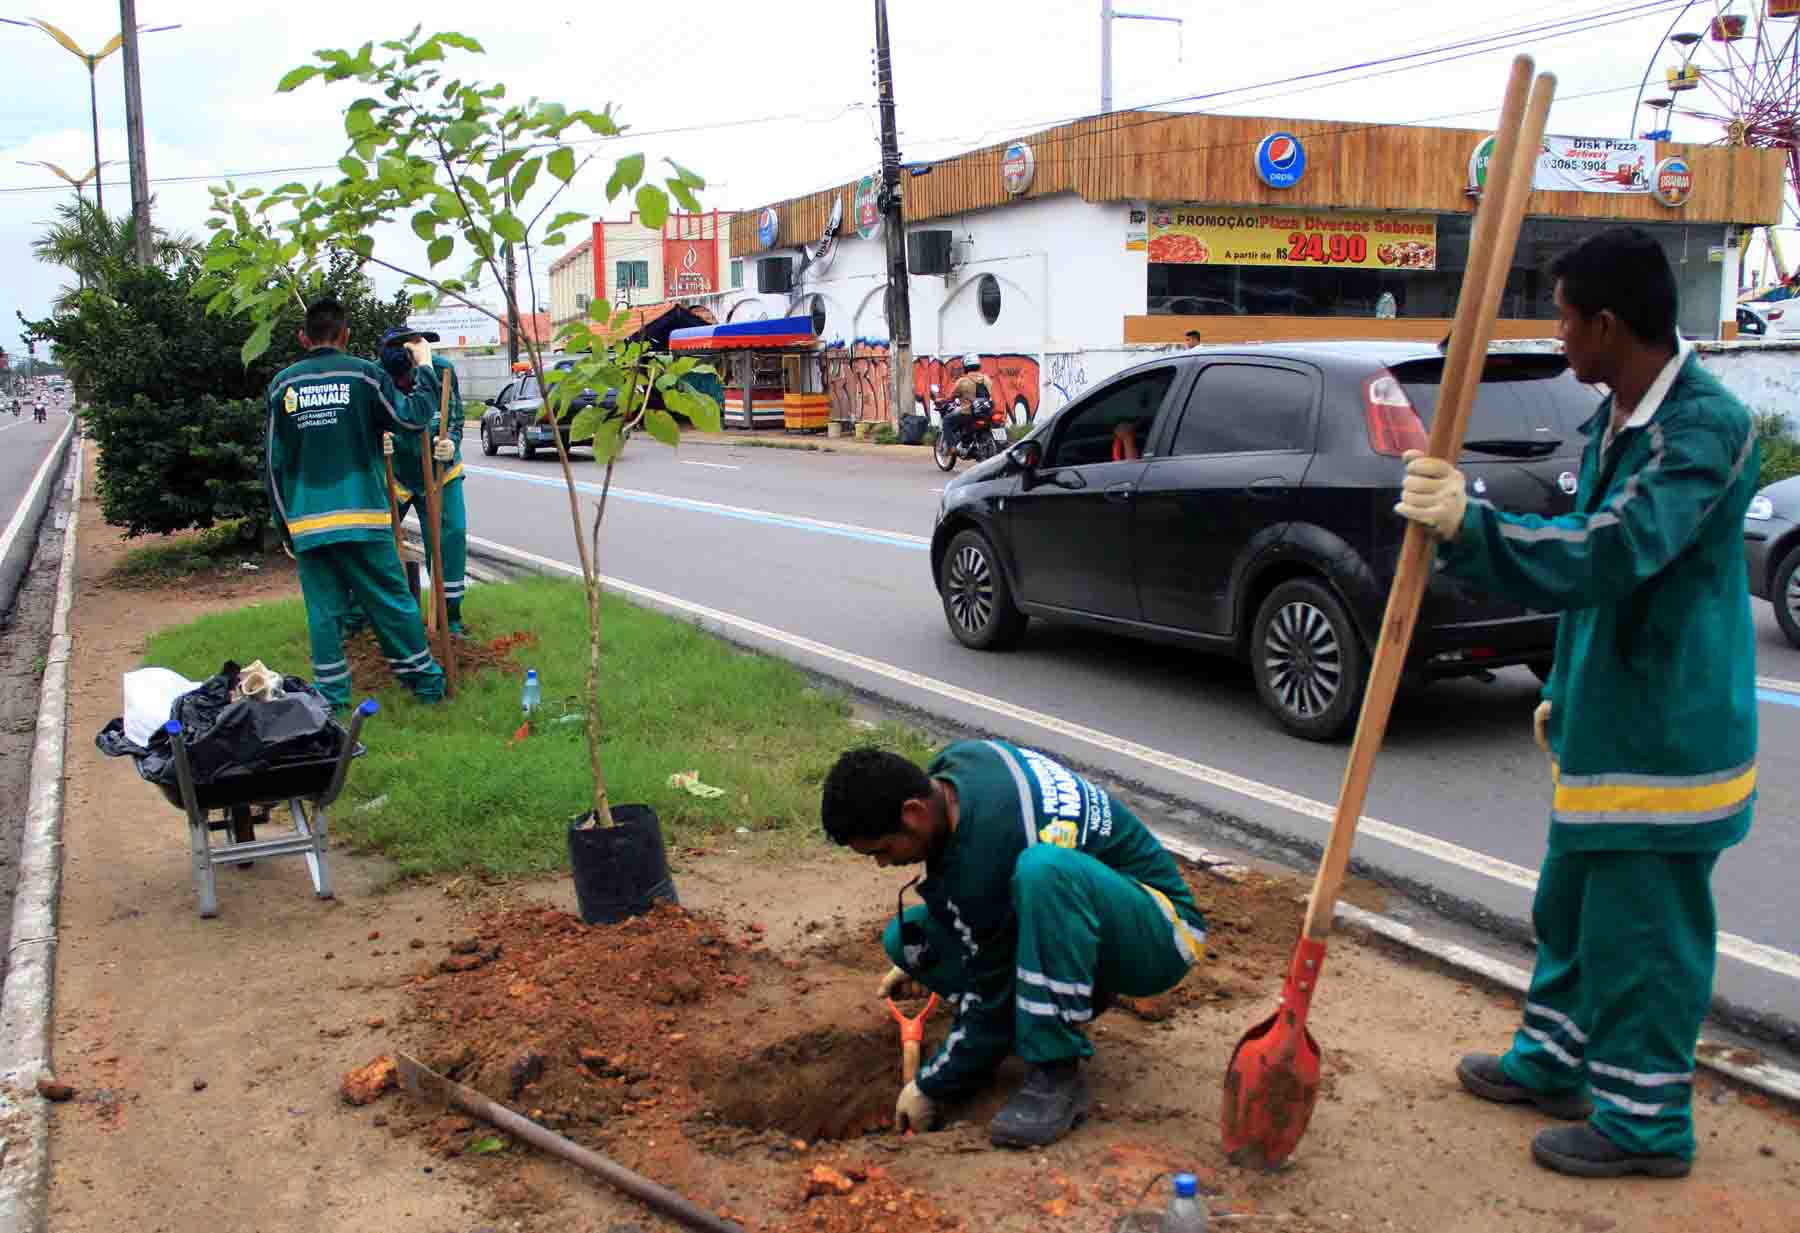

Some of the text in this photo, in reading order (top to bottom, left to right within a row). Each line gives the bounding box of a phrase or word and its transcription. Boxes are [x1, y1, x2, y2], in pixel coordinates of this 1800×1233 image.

[1574, 139, 1637, 151] Disk Pizza
[1225, 250, 1231, 258] A
[1233, 250, 1258, 261] partir
[1287, 231, 1367, 264] 24,90
[340, 383, 350, 392] DE
[299, 391, 350, 409] MANAUS
